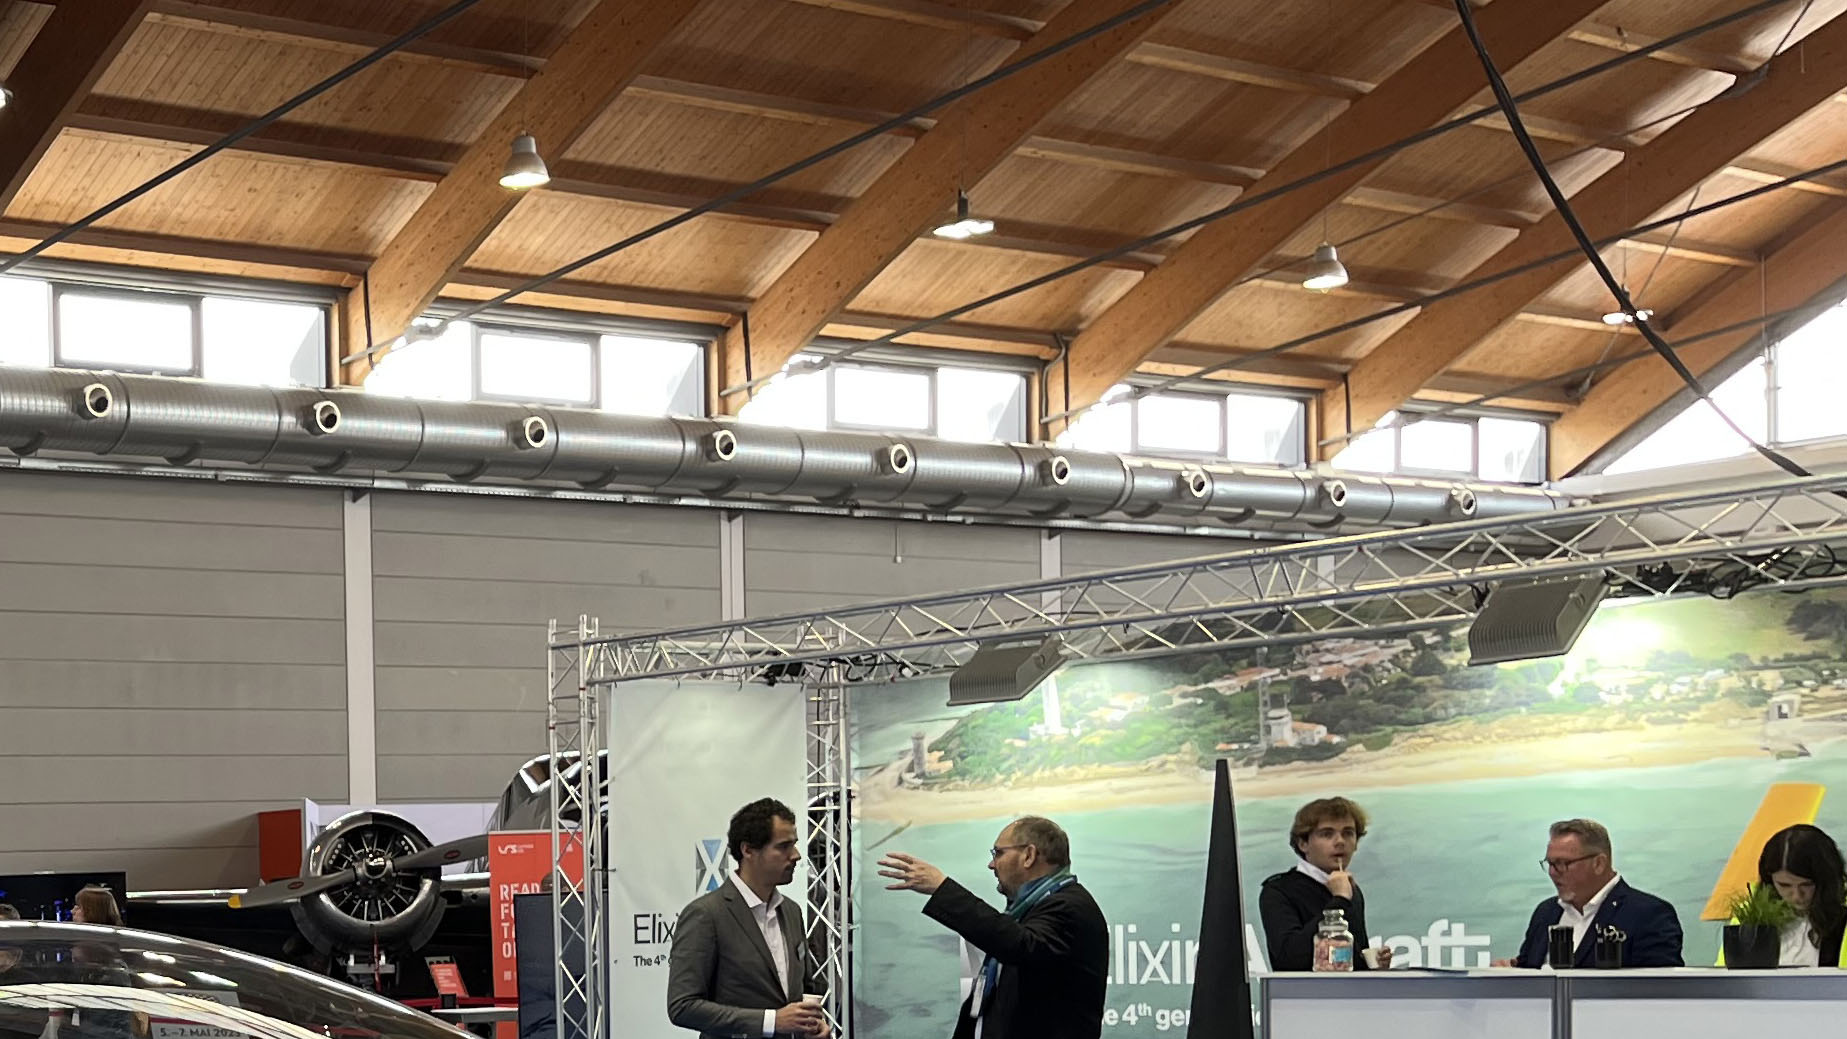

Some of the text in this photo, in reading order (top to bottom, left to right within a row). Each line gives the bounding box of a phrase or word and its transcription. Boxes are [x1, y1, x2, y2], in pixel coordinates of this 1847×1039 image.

[499, 882, 541, 901] READ
[633, 955, 653, 967] The
[1106, 922, 1200, 985] lixir
[1121, 1002, 1153, 1026] 4th
[189, 1027, 211, 1037] MAI
